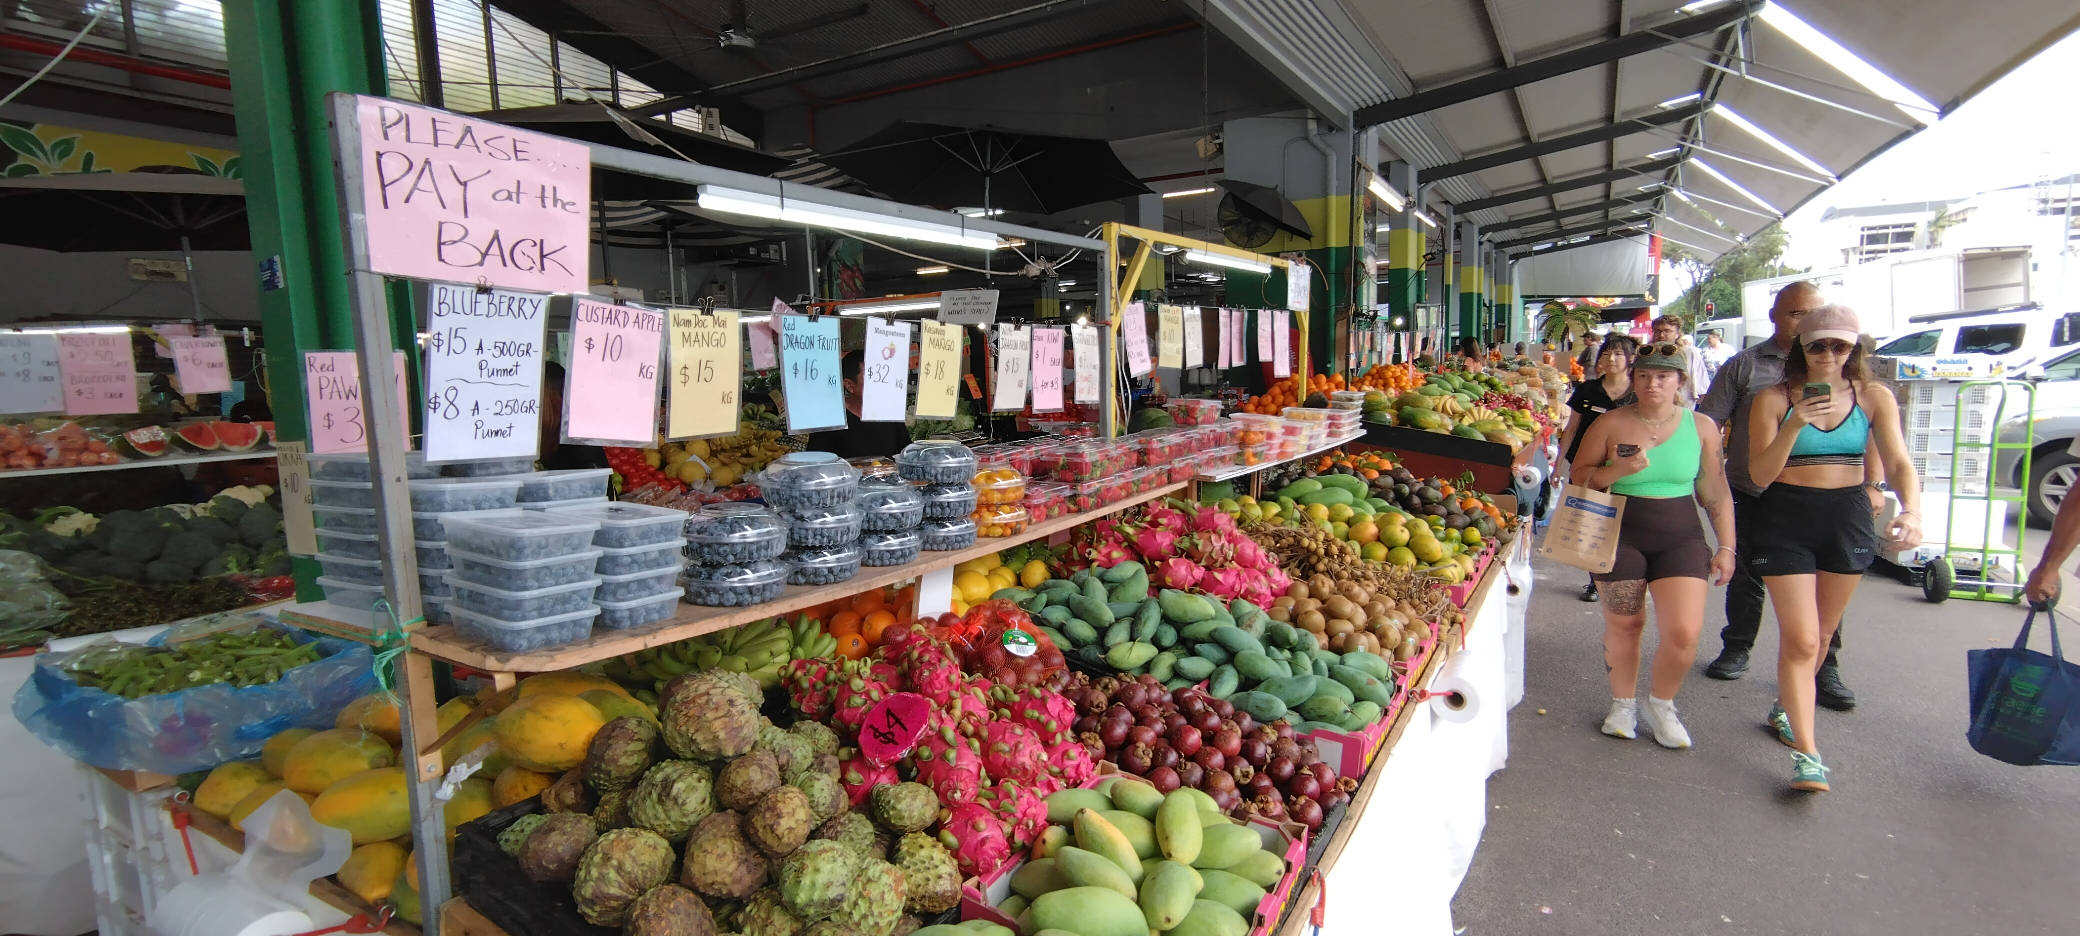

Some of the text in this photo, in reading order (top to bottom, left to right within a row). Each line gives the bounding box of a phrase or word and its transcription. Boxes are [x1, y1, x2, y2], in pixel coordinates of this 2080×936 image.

[376, 151, 581, 218] PAY at the
[436, 221, 574, 276] BACK
[434, 286, 541, 320] BLUEBERRY
[576, 302, 664, 333] CUSTARD APPLE
[712, 315, 728, 329] Mai
[783, 317, 796, 331] Red
[682, 331, 726, 348] MANGO
[874, 327, 906, 338] Mangosteen
[783, 333, 839, 351] DRAGON FRUIT
[929, 337, 955, 352] MANGO
[308, 355, 335, 374] Red
[478, 359, 520, 378] Punnet
[638, 362, 654, 380] KG
[828, 375, 837, 387] KG
[721, 391, 733, 405] KG
[474, 419, 515, 440] Punnet
